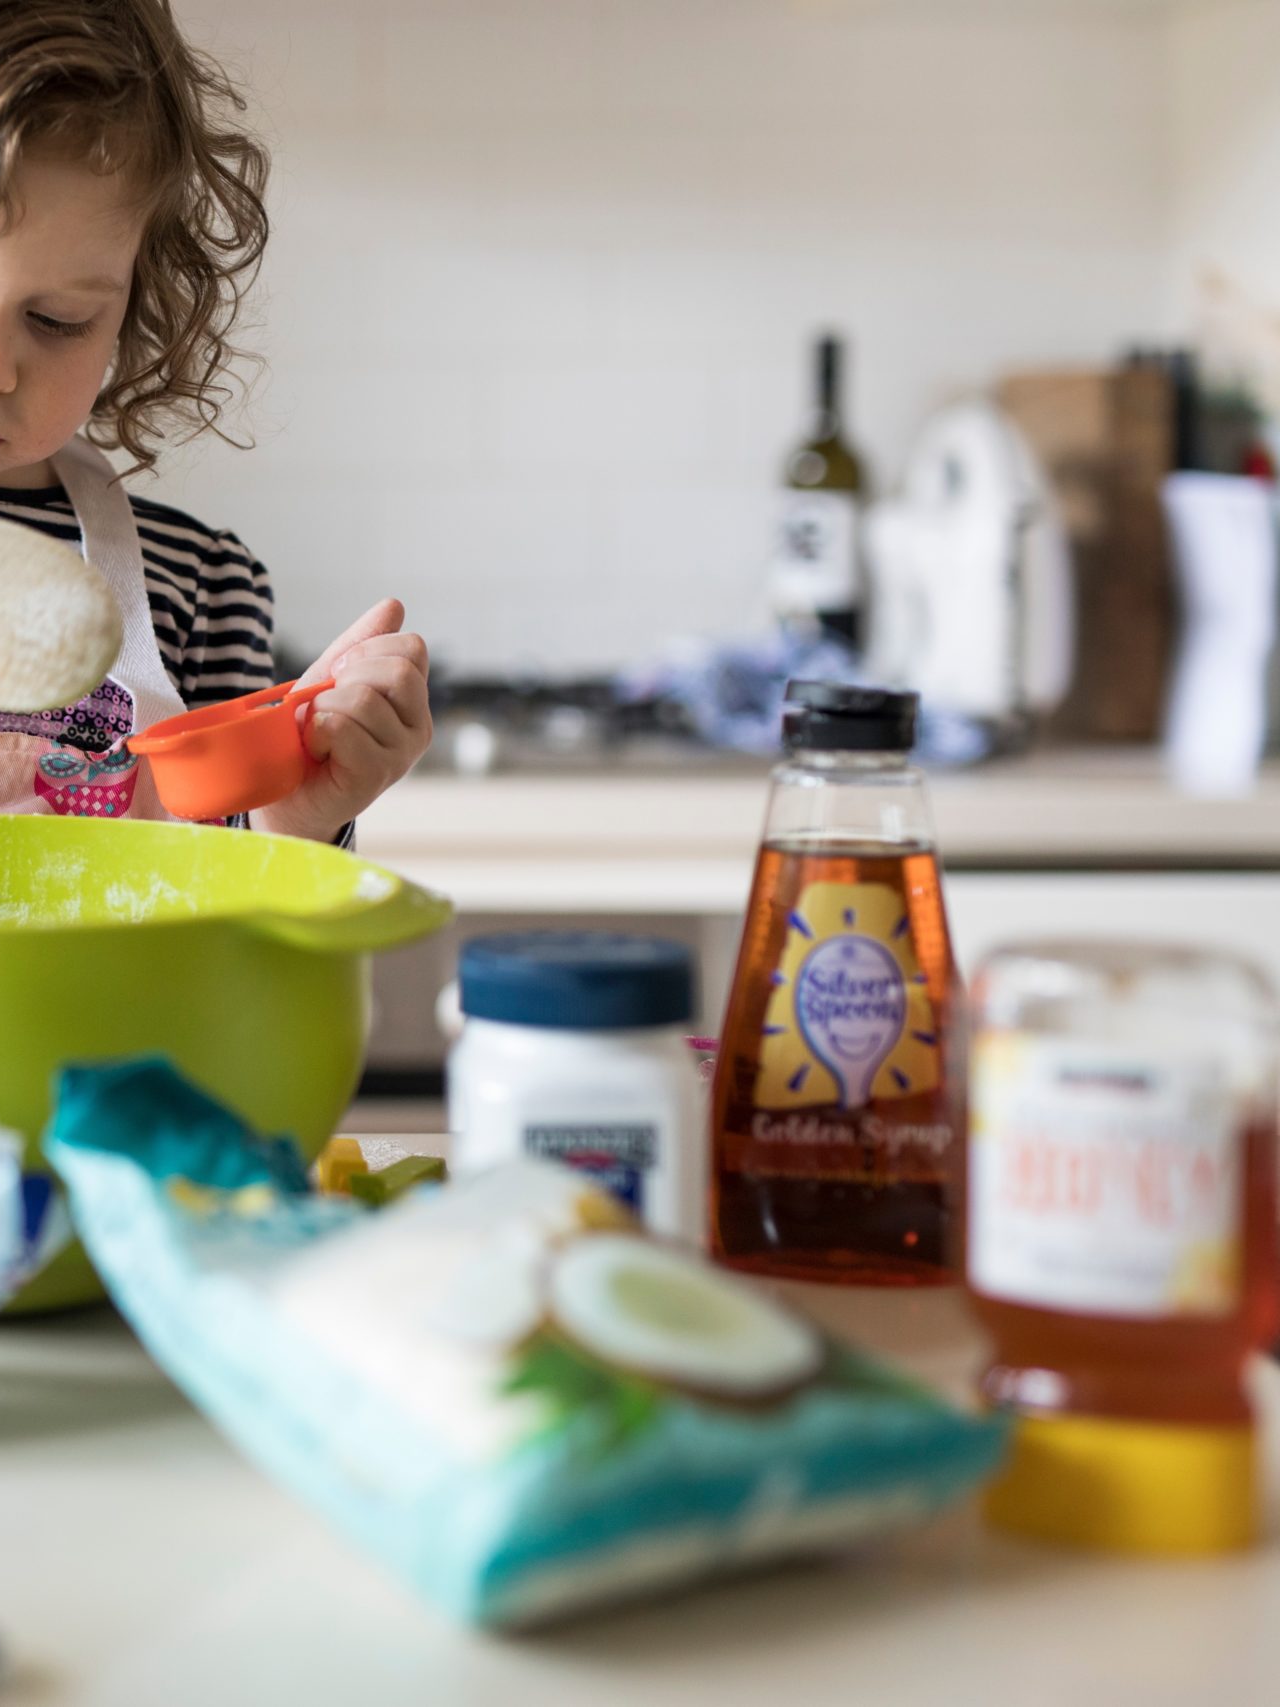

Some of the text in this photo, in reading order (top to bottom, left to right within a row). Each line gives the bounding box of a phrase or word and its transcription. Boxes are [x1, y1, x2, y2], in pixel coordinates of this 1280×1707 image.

[807, 968, 900, 996] Silver
[806, 1000, 902, 1027] Spoon
[752, 1113, 952, 1154] Golden Syrup
